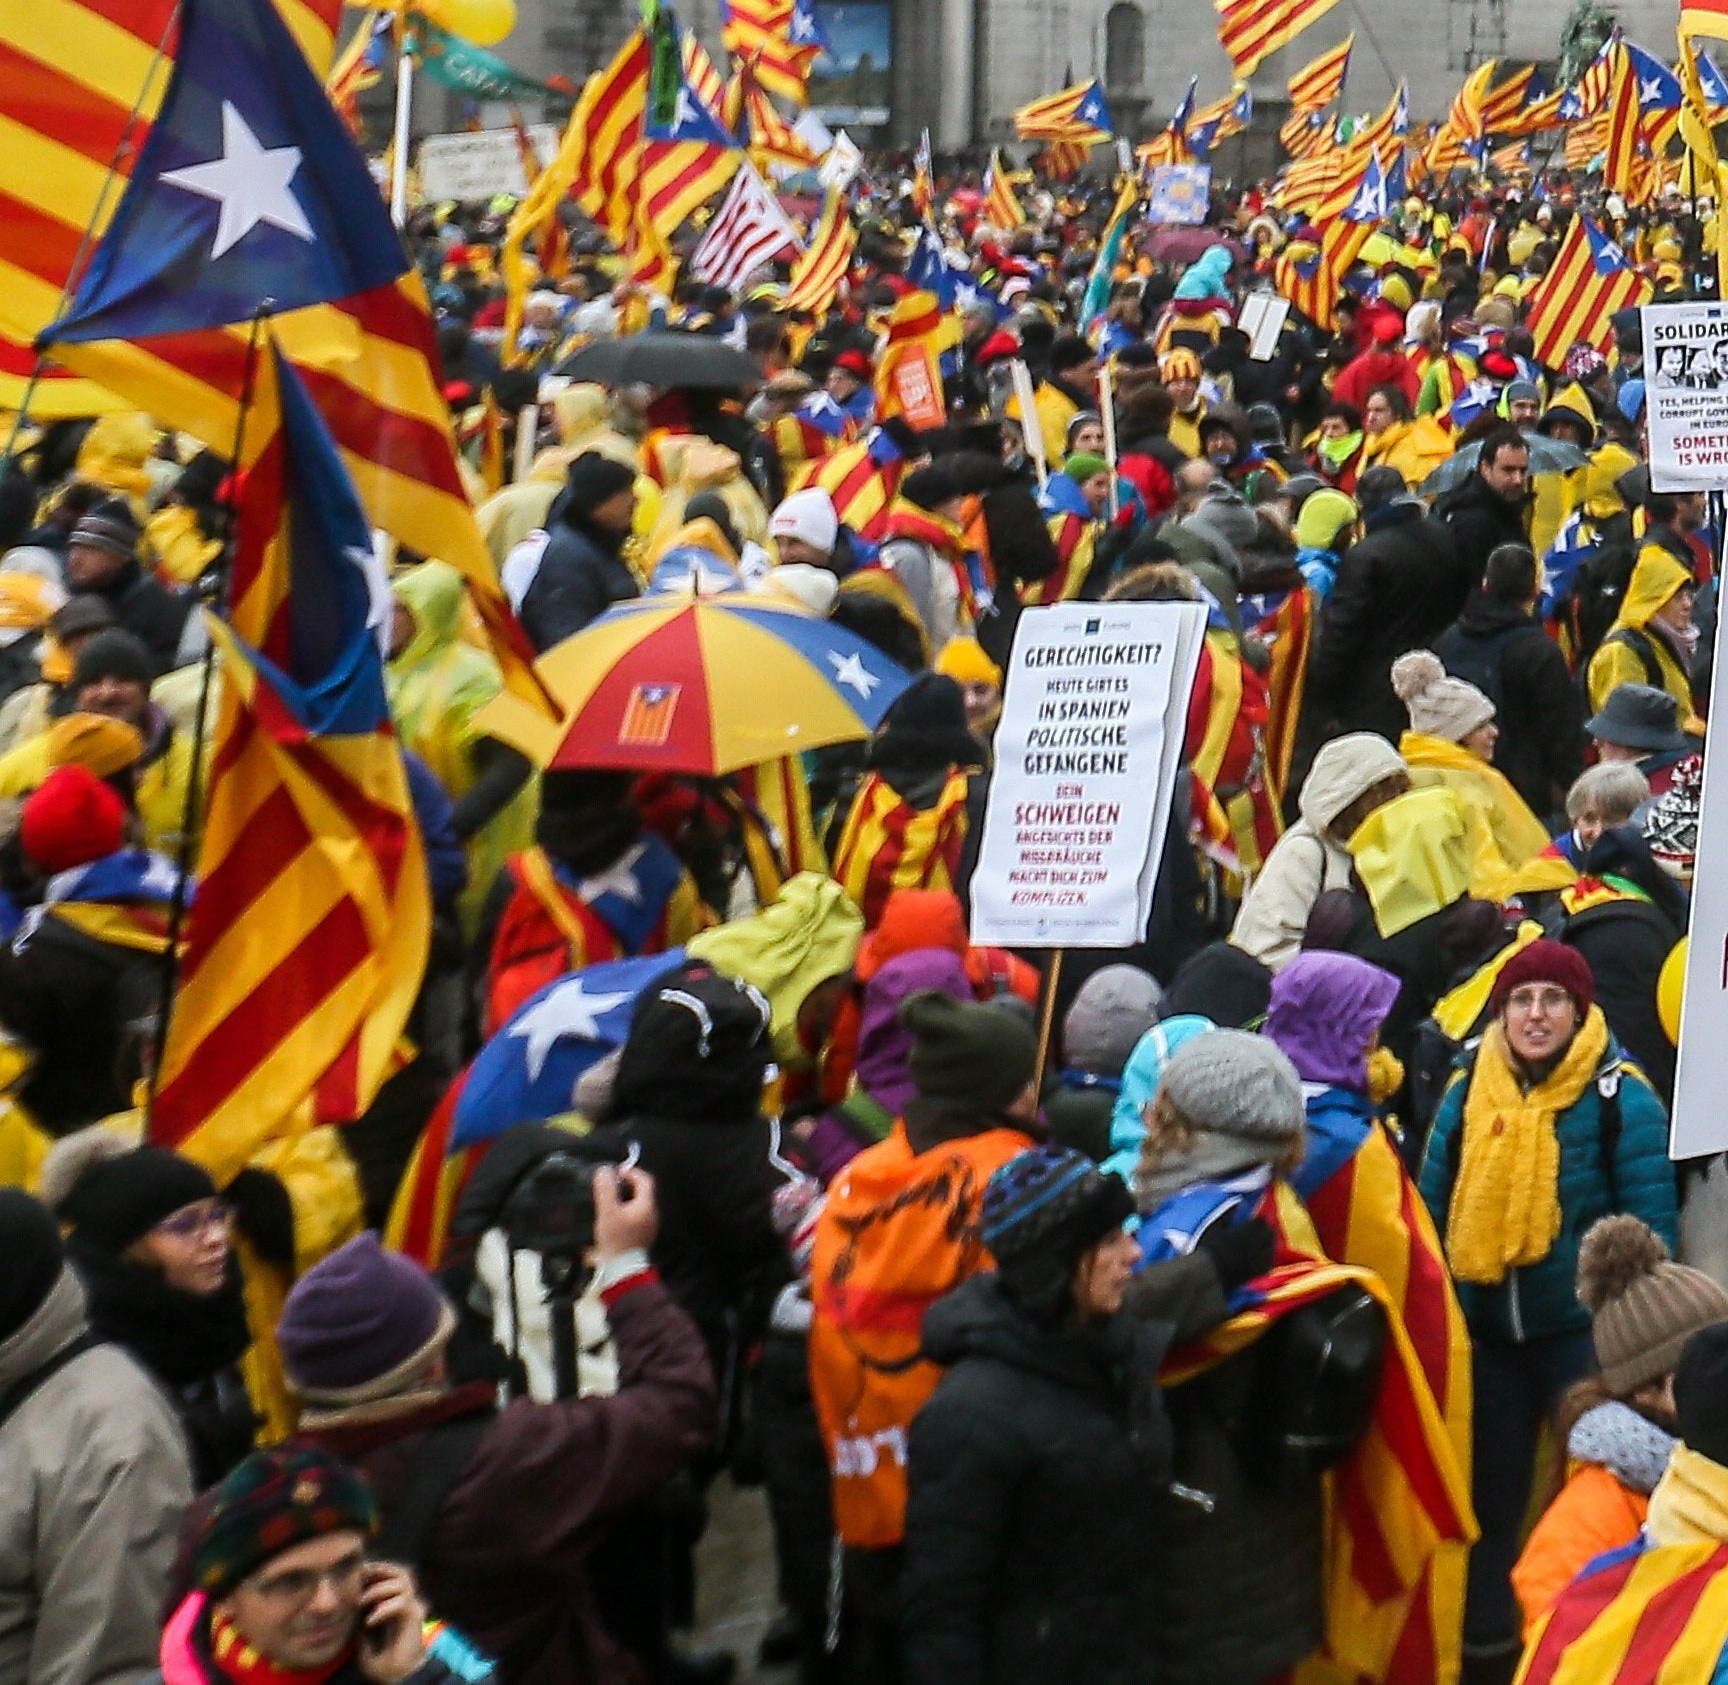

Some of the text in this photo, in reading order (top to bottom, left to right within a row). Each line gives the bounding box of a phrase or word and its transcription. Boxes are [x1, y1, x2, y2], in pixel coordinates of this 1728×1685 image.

[1659, 397, 1680, 408] YES,
[1682, 396, 1723, 407] HELPING
[1660, 409, 1704, 419] CORRUPT
[1690, 421, 1700, 429] IN
[1679, 453, 1692, 466] IS
[1025, 644, 1162, 668] GERECHTIGKEIT?
[1047, 677, 1128, 693] HEUTE GIBT ES
[1039, 699, 1131, 721] IN SPANIEN
[1026, 725, 1128, 748] POLITISCHE
[1024, 752, 1128, 775] GEFANGENE
[1015, 803, 1121, 825] SCHWEIGEN
[1088, 830, 1113, 844] DER
